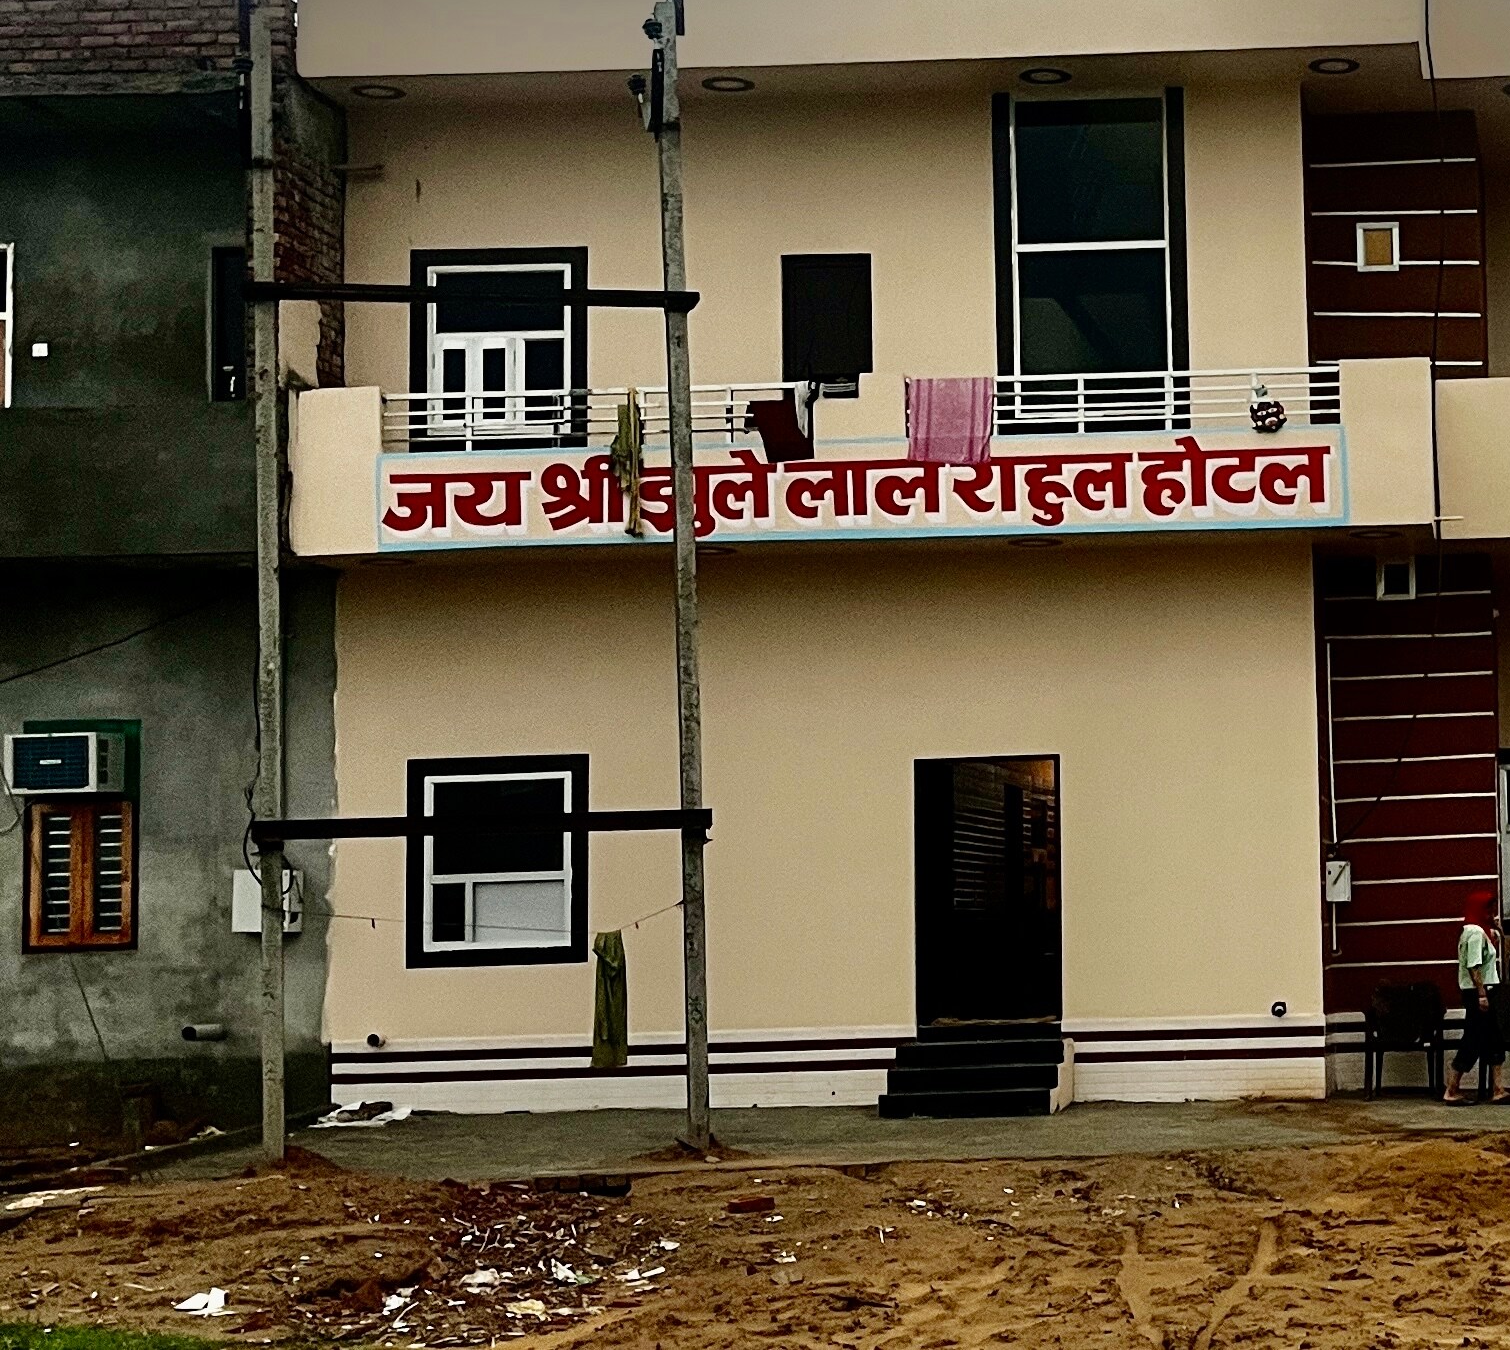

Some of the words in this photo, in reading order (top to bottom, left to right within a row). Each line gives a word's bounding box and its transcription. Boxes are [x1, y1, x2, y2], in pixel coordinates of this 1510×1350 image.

[381, 470, 532, 531] जय
[540, 454, 626, 531] श्री
[783, 459, 946, 519] लाल
[949, 452, 1134, 526] राहुल
[1137, 436, 1331, 516] होटल
